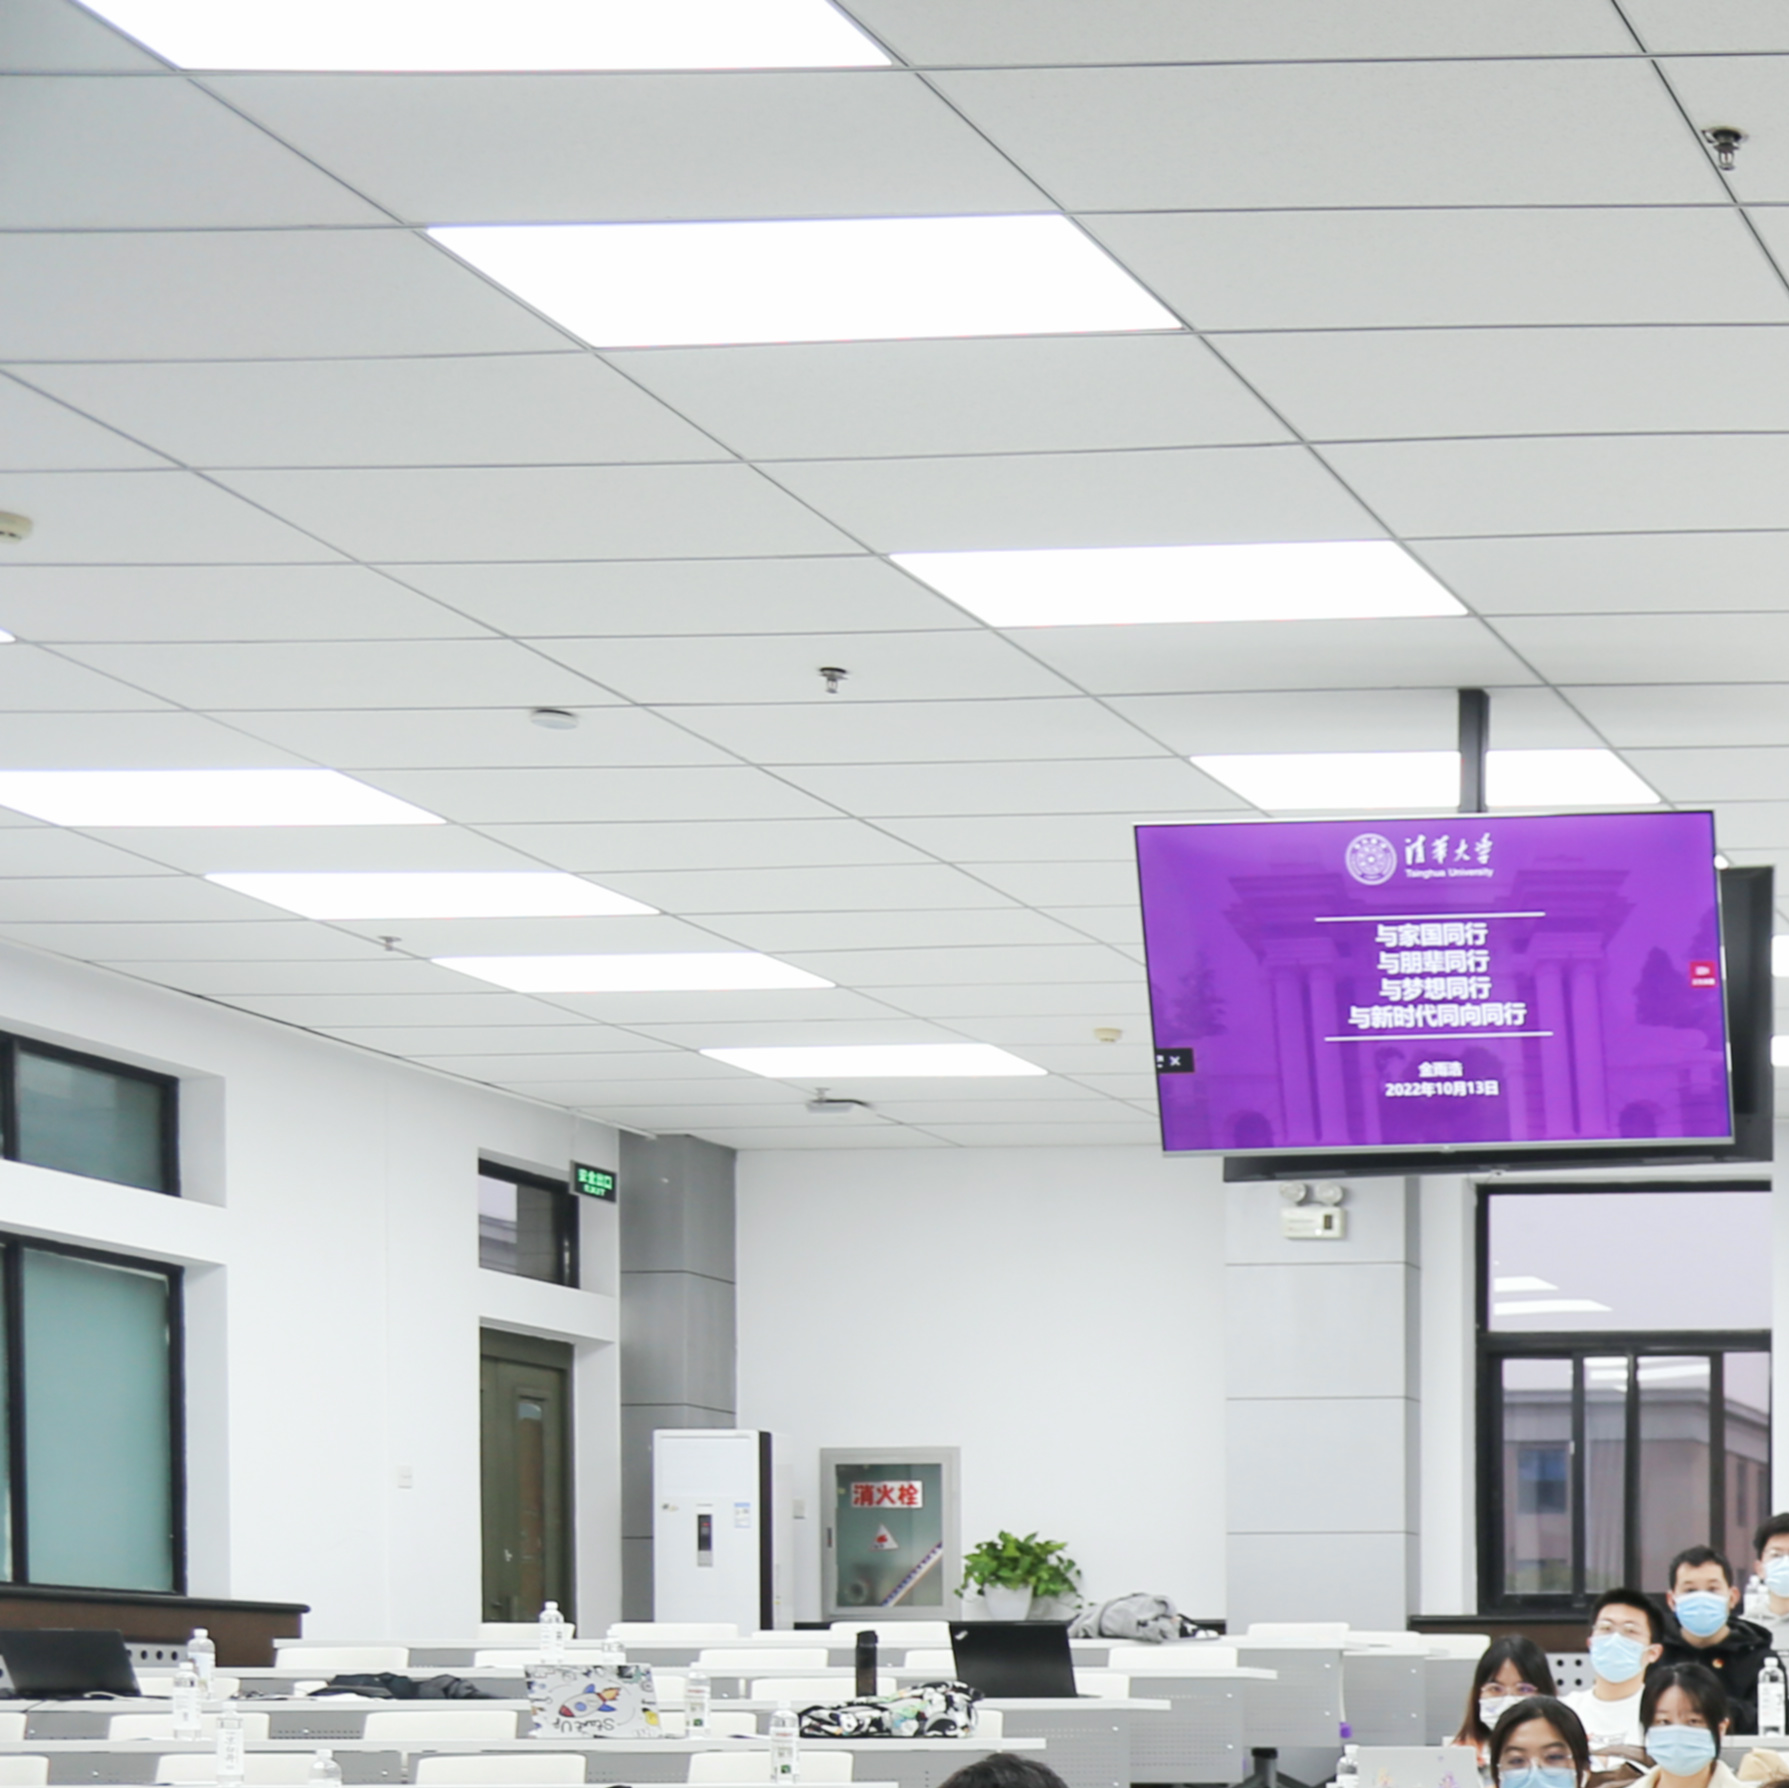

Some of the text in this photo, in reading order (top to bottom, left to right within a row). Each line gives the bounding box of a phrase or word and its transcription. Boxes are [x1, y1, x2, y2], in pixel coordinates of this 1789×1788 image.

[1375, 922, 1488, 947] 与家国同行
[1377, 949, 1490, 974] 与朋辈同行
[1379, 976, 1492, 1001] 与梦想同行
[1348, 1002, 1527, 1029] 与新时代同向同行
[1385, 1080, 1499, 1097] 2022年10月13日
[853, 1483, 919, 1507] 消火栓
